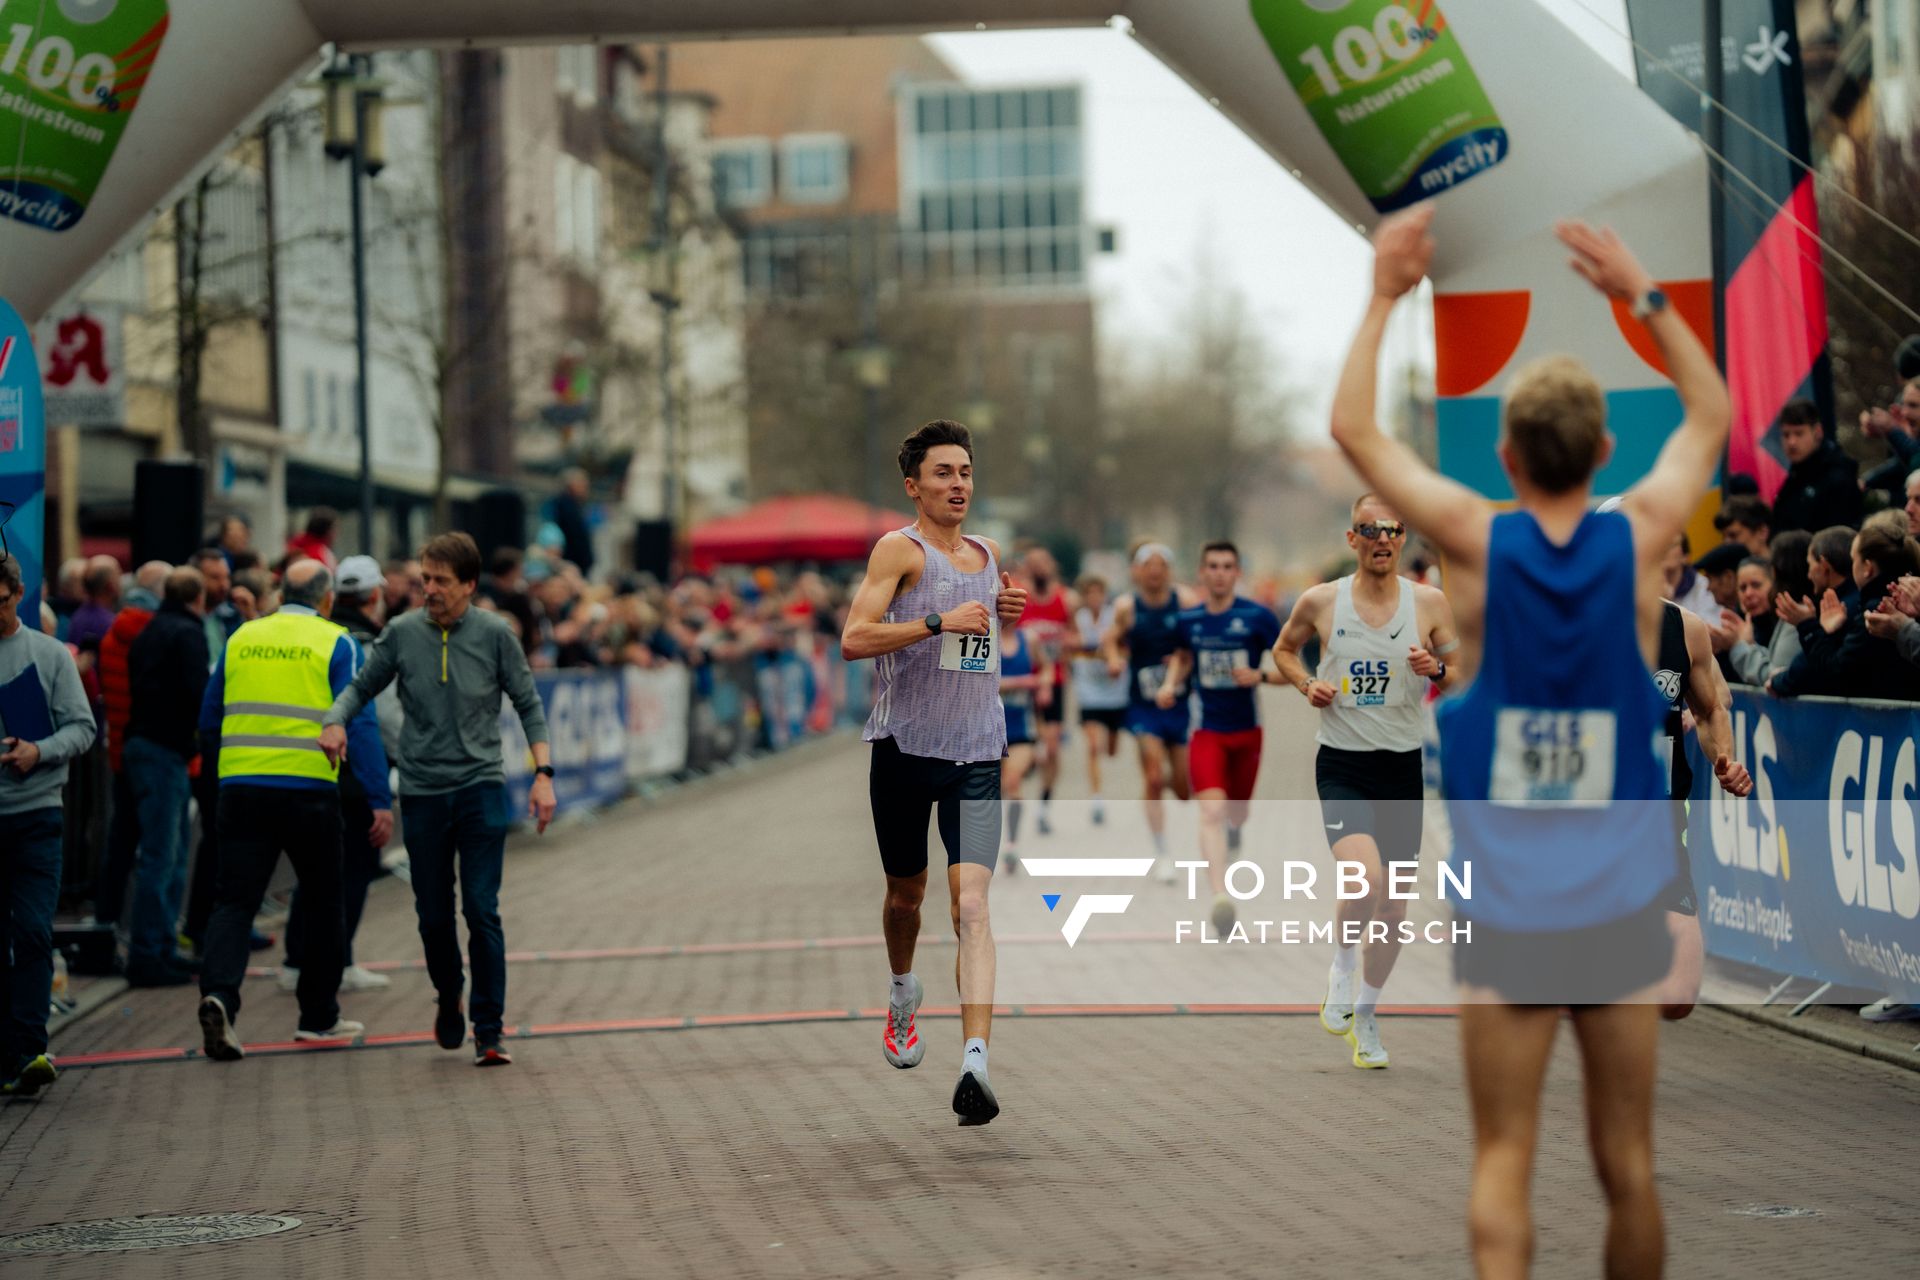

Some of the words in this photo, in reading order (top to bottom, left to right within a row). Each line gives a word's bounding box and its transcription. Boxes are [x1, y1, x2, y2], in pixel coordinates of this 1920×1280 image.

[0, 23, 119, 112] 100%
[1298, 5, 1438, 96] 100%
[0, 85, 105, 144] aturstrom
[1335, 58, 1454, 124] Naturstrom
[1420, 138, 1498, 190] mycity
[239, 645, 312, 660] ORDNER
[959, 636, 990, 658] 175
[1352, 677, 1390, 695] 327
[1829, 729, 1920, 920] GLS
[1707, 885, 1745, 931] Parcels
[1746, 897, 1757, 935] to
[1755, 896, 1793, 952] People
[1839, 928, 1886, 975] Parcels
